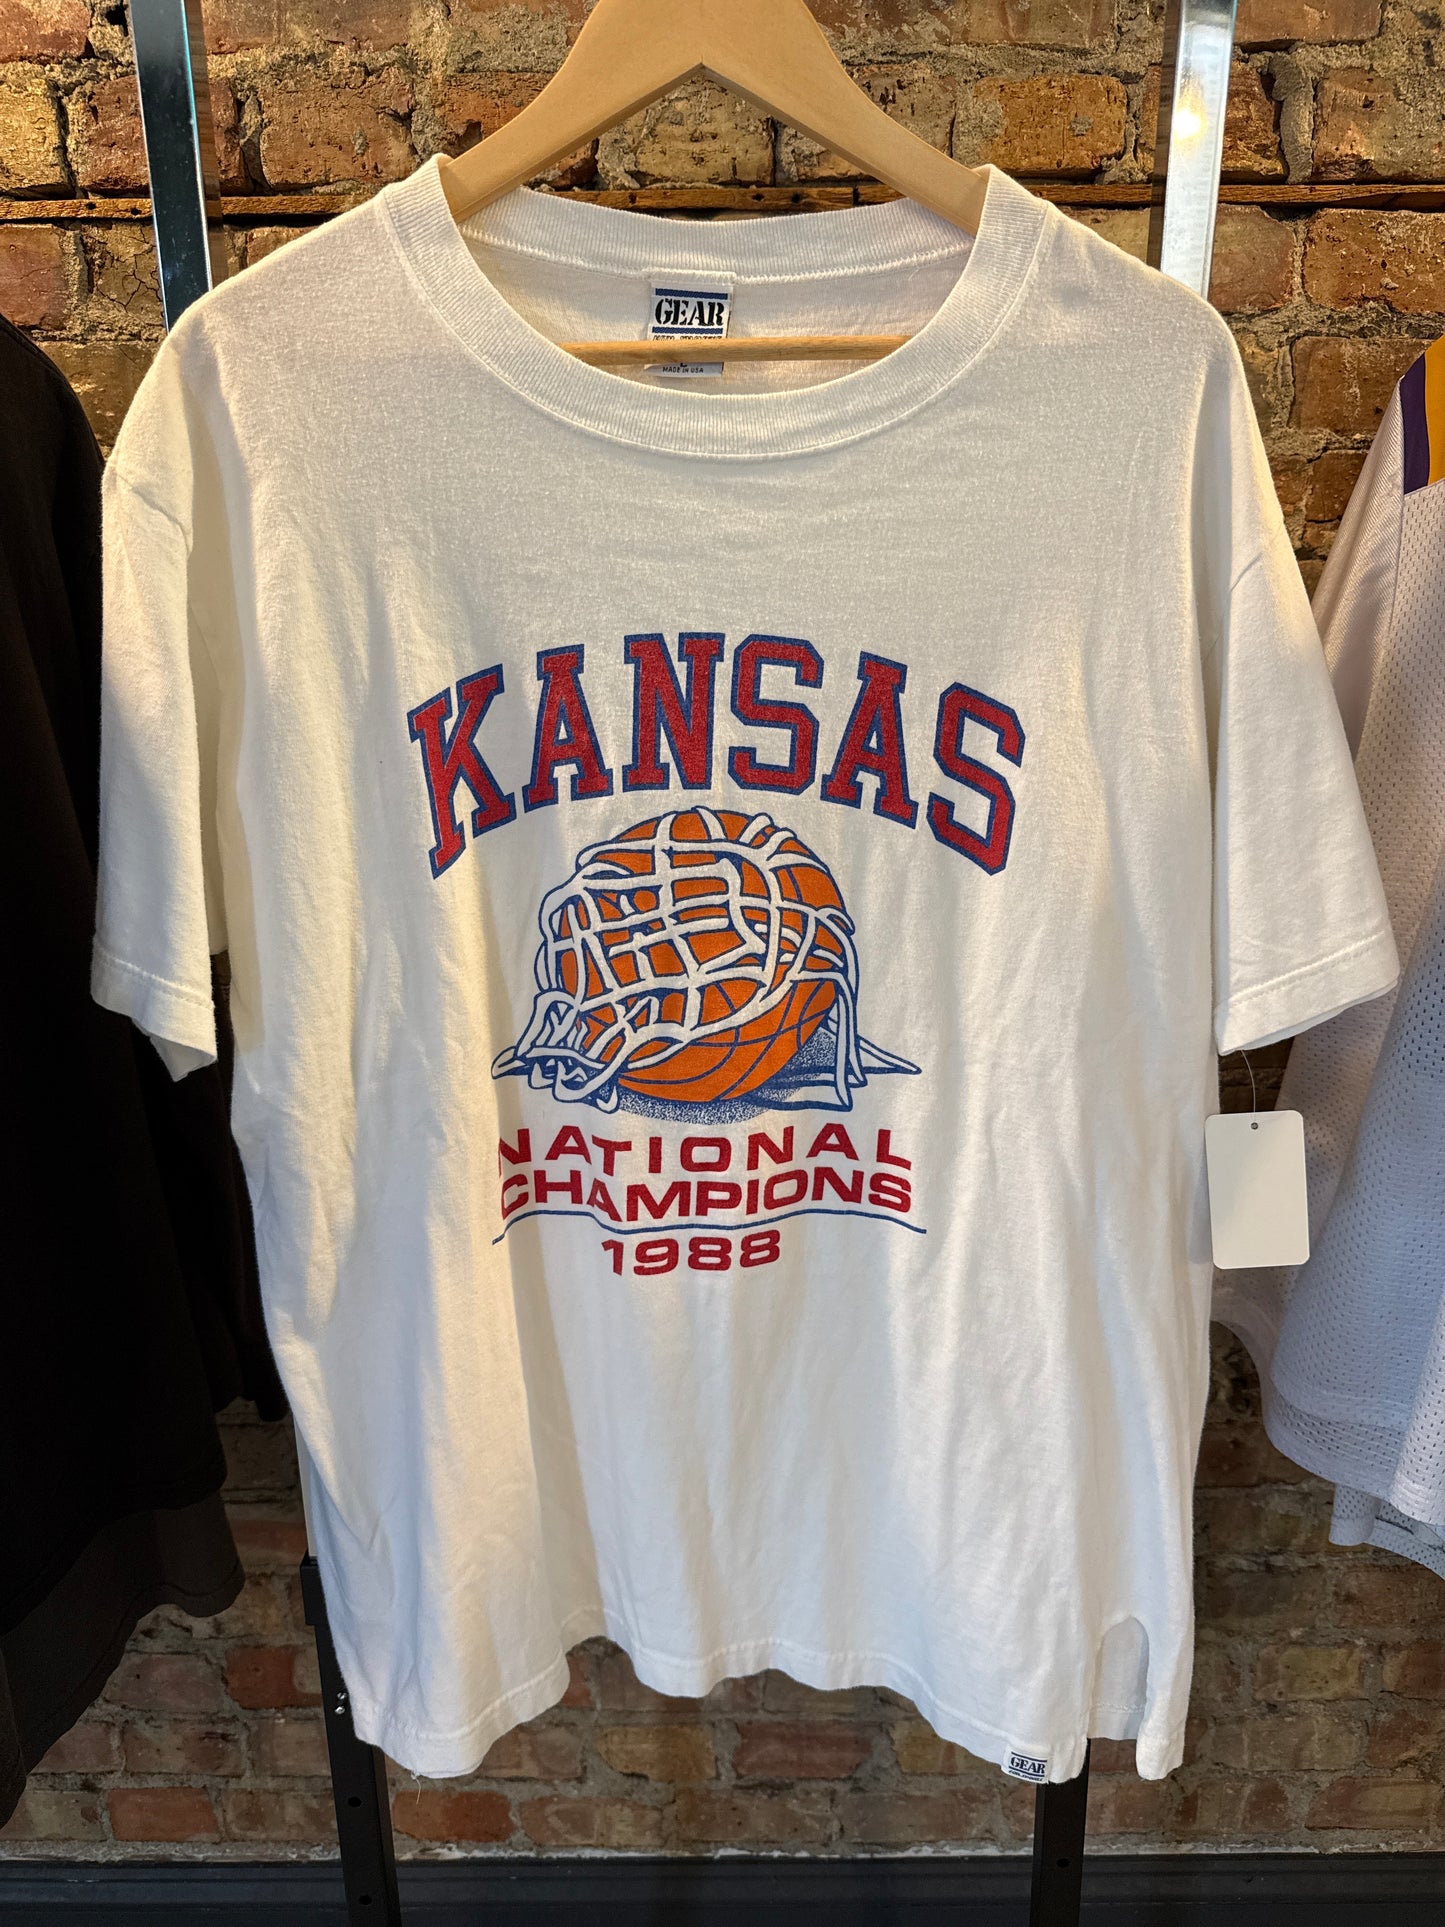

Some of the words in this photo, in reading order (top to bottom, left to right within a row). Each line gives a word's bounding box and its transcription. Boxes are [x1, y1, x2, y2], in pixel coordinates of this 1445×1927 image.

[654, 298, 725, 327] GEAR
[662, 366, 681, 374] MADE
[682, 366, 689, 374] IN
[690, 366, 704, 374] USA
[407, 631, 1026, 880] KANSAS
[498, 1122, 913, 1178] NATIONAL
[501, 1166, 913, 1222] CHAMPIONS
[602, 1229, 781, 1276] 1988
[1010, 1756, 1046, 1774] GEAR
